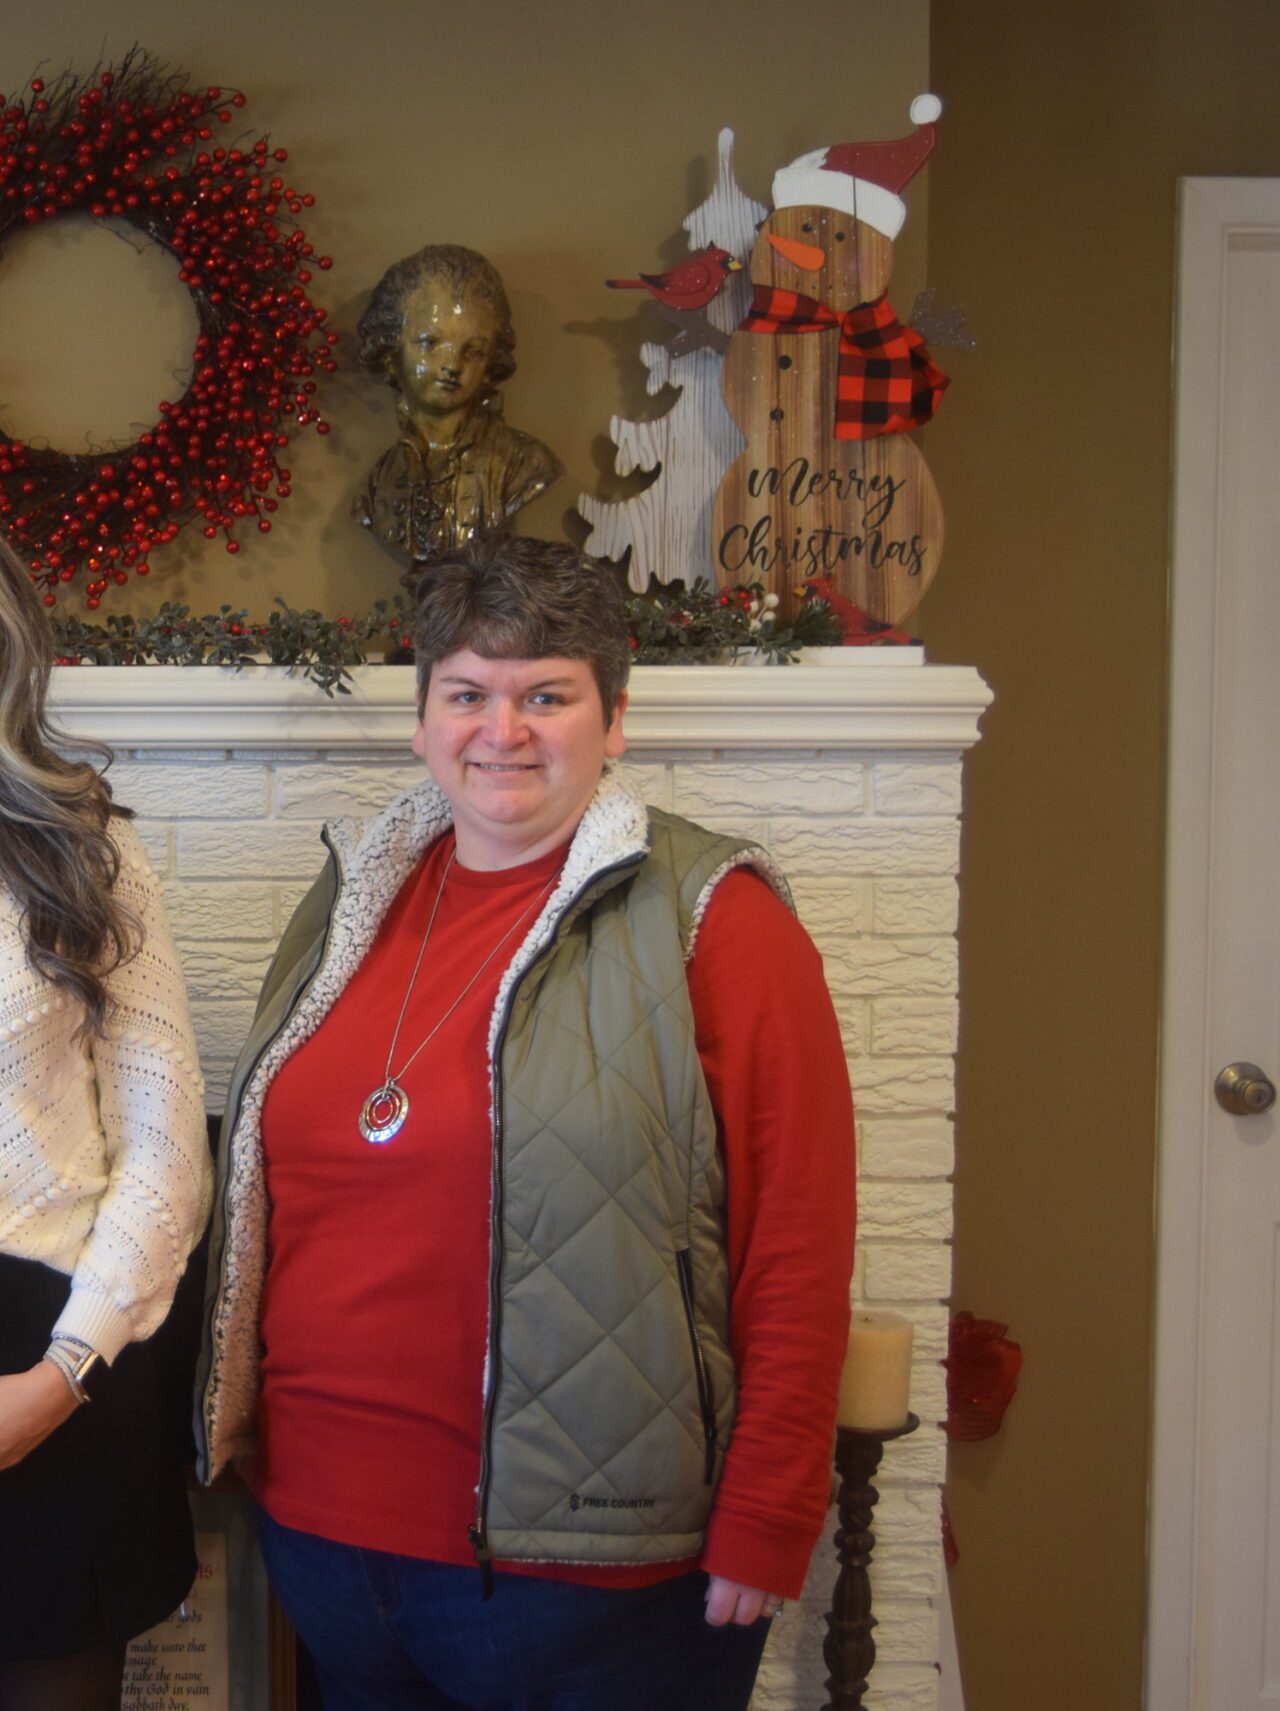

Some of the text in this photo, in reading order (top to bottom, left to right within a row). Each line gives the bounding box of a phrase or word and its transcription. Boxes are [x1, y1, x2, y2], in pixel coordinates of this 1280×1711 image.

[748, 457, 906, 529] Merry
[719, 515, 928, 577] Christmas
[583, 1498, 656, 1508] FREE COUNTRY
[130, 1638, 207, 1652] make unto thee
[132, 1667, 154, 1681] take
[156, 1666, 170, 1680] the
[174, 1672, 202, 1681] name
[124, 1682, 210, 1696] thy God in vain
[122, 1697, 164, 1710] sabbath
